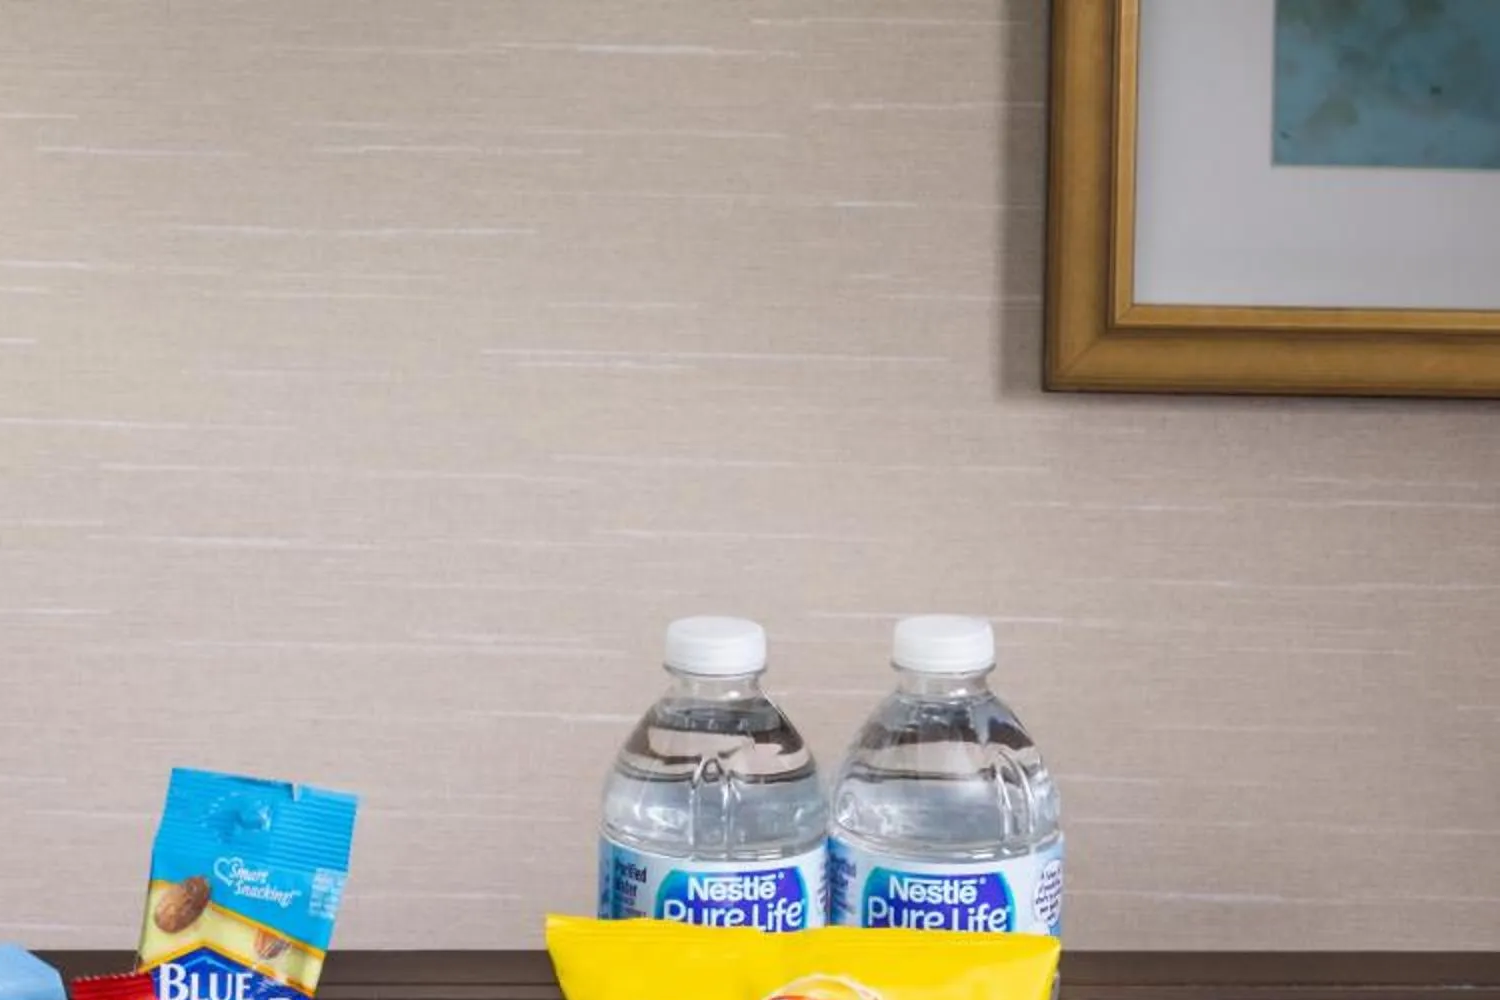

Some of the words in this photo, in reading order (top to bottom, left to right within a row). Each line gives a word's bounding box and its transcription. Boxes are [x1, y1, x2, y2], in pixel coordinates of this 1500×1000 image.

[663, 898, 746, 928] Pure
[752, 898, 803, 933] Life
[867, 896, 945, 930] Pure
[952, 903, 1007, 933] Life
